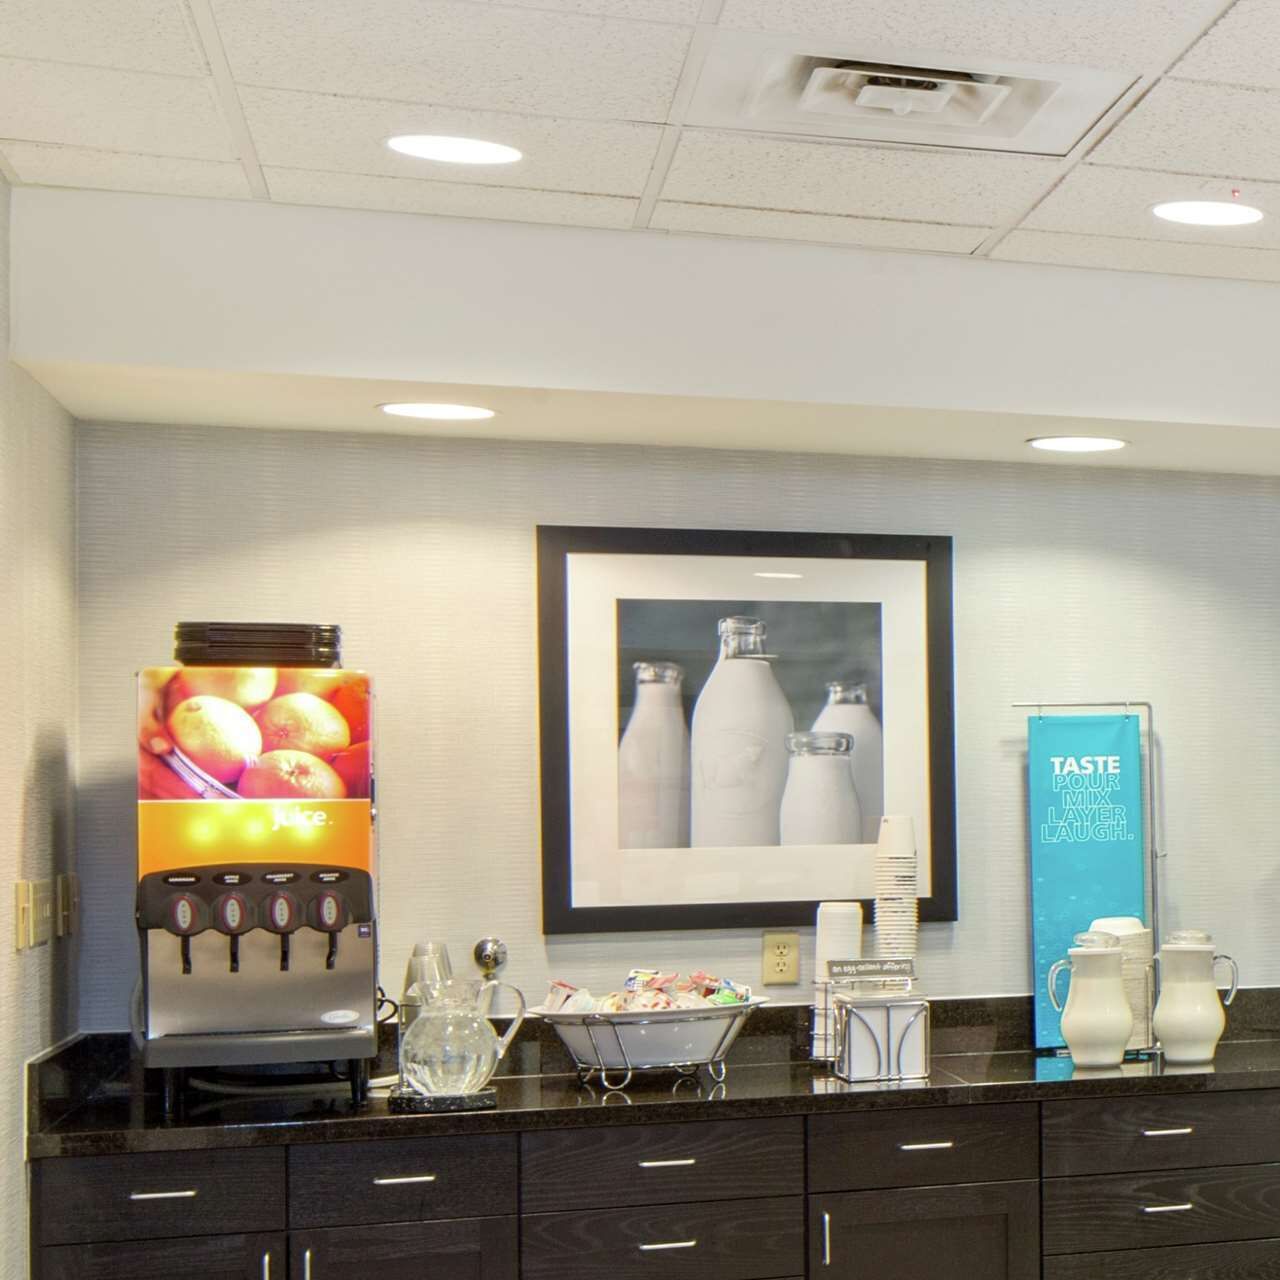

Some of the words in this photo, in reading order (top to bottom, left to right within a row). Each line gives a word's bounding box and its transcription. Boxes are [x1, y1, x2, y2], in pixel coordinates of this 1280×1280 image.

[1049, 756, 1120, 775] TASTE
[1052, 772, 1121, 792] POUR
[1062, 788, 1112, 808] MIX
[1048, 805, 1127, 826] LAYER
[1041, 821, 1135, 843] LAUGH.
